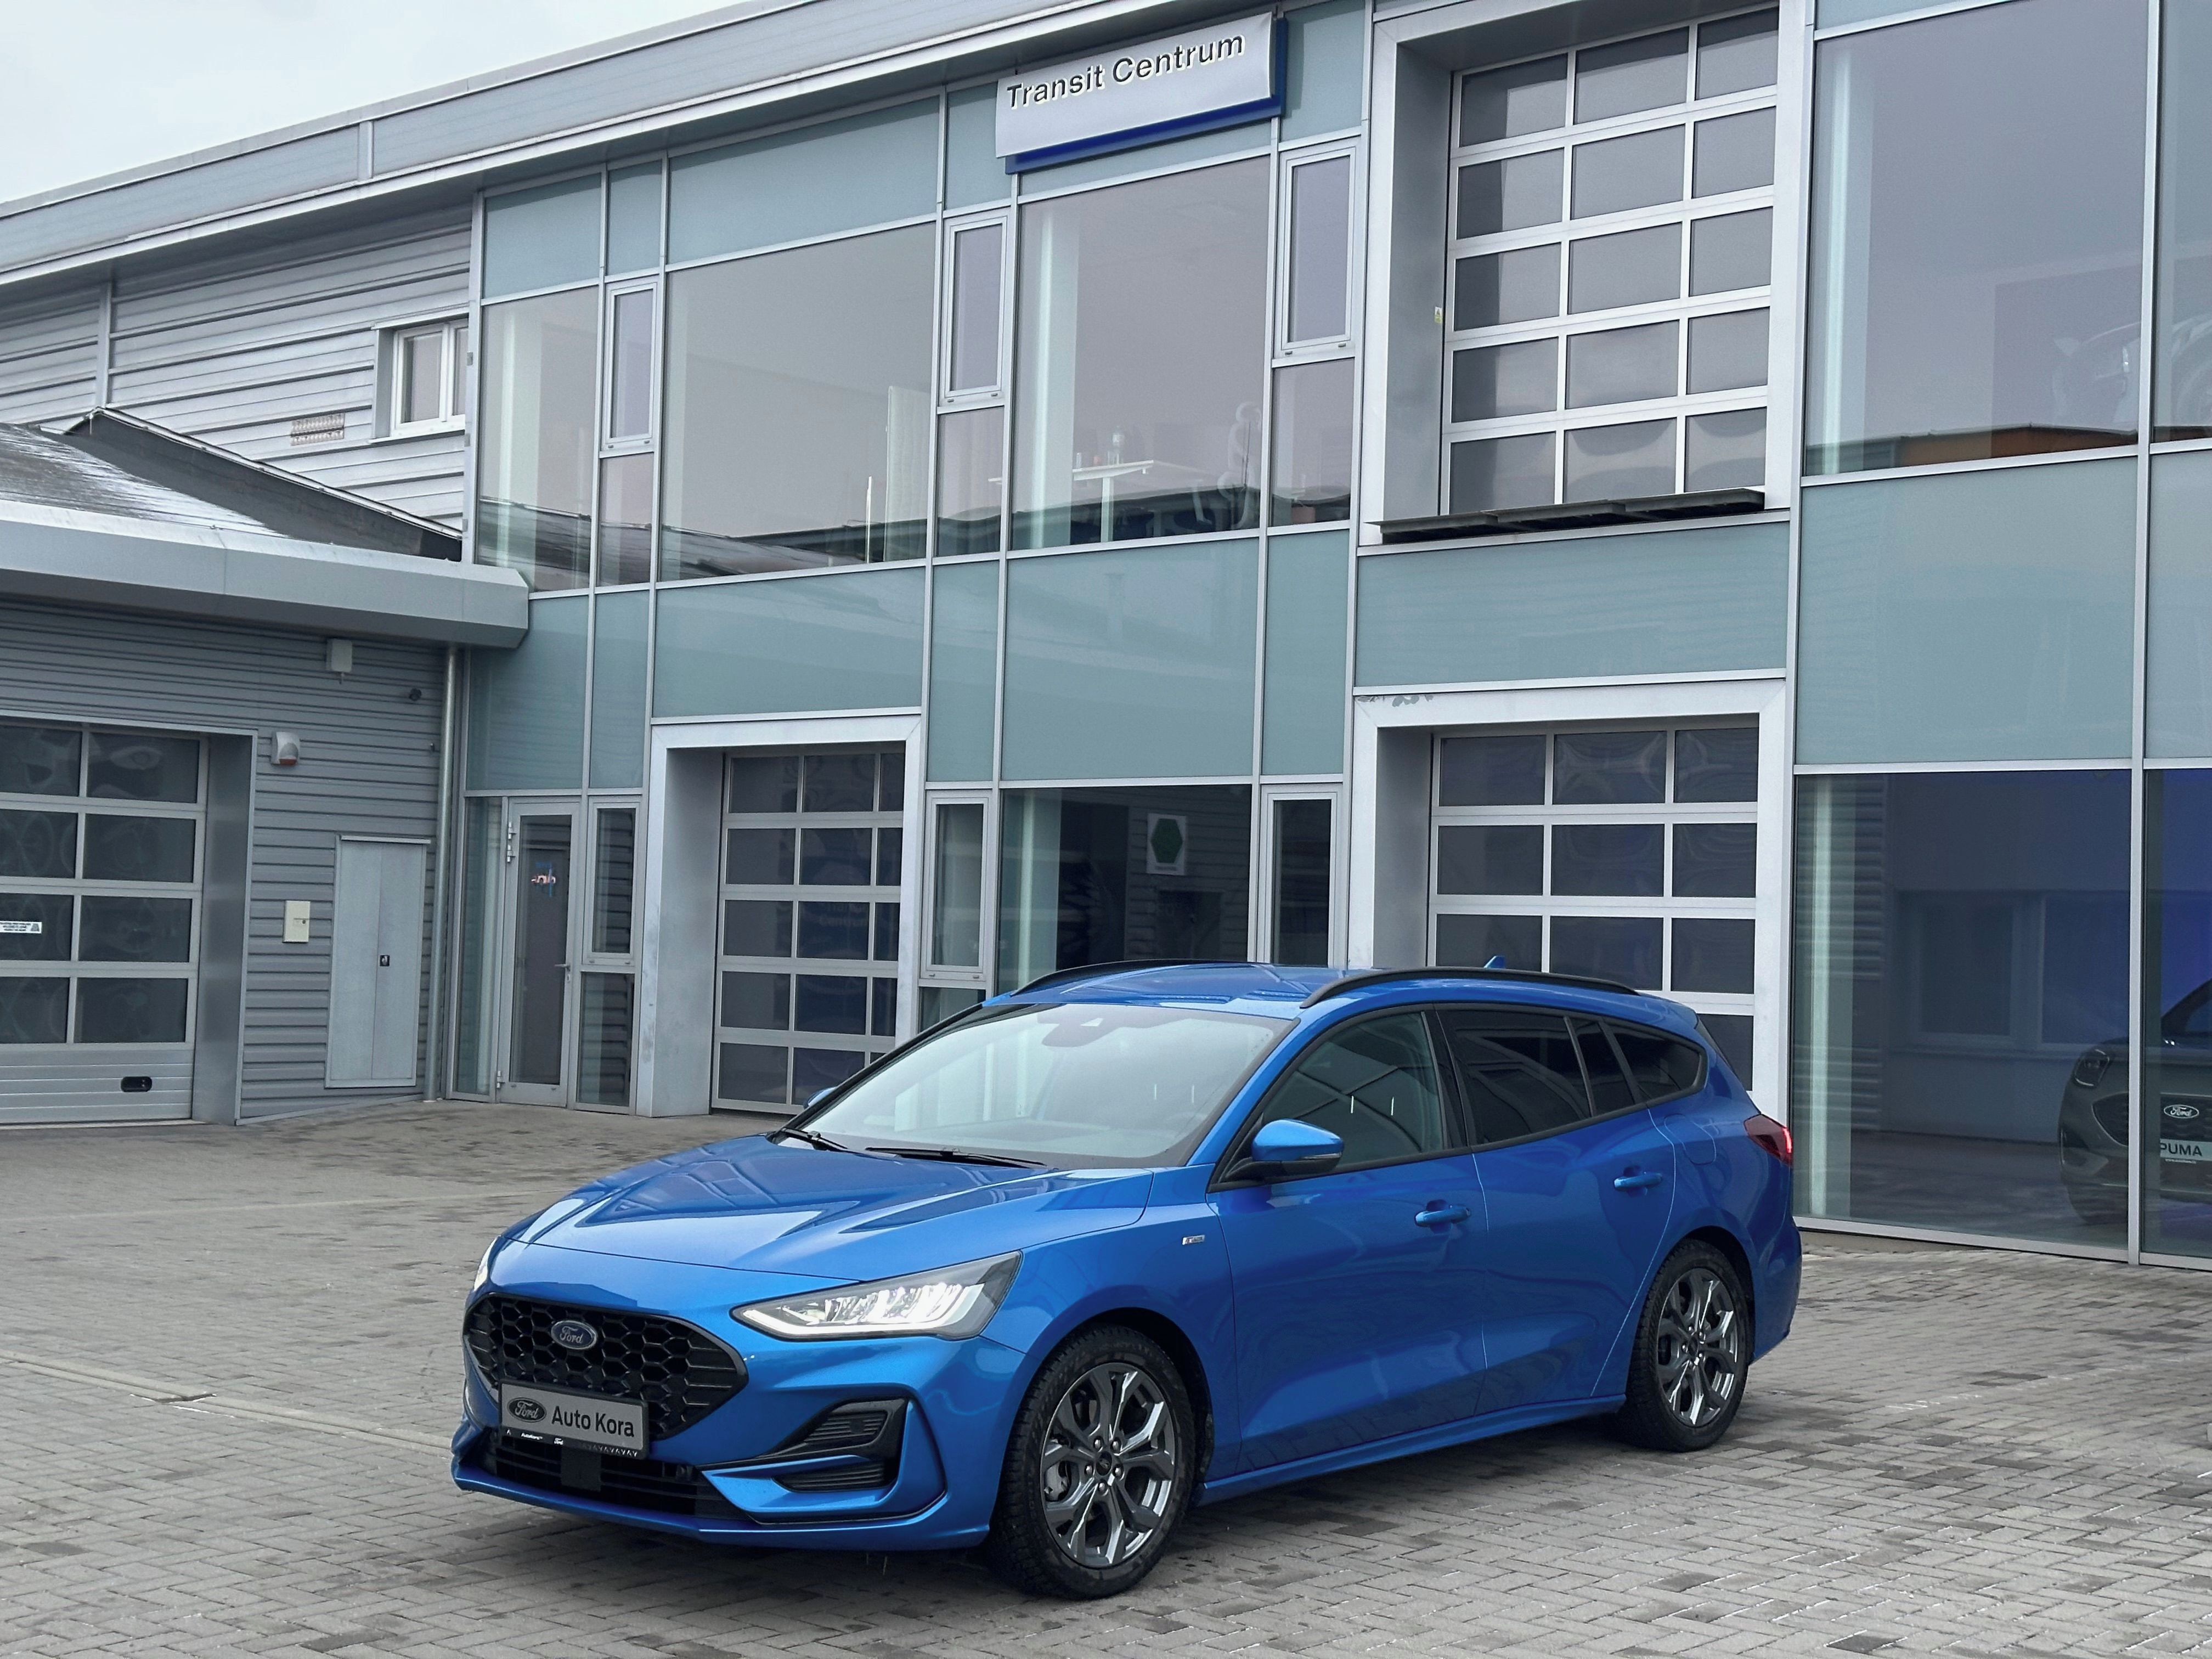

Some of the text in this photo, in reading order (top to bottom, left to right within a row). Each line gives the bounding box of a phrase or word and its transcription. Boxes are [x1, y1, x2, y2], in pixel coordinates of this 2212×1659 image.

[1007, 35, 1244, 109] Transit Centrum
[559, 1326, 583, 1344] Ford
[515, 1400, 634, 1437] Ford Auto Kora
